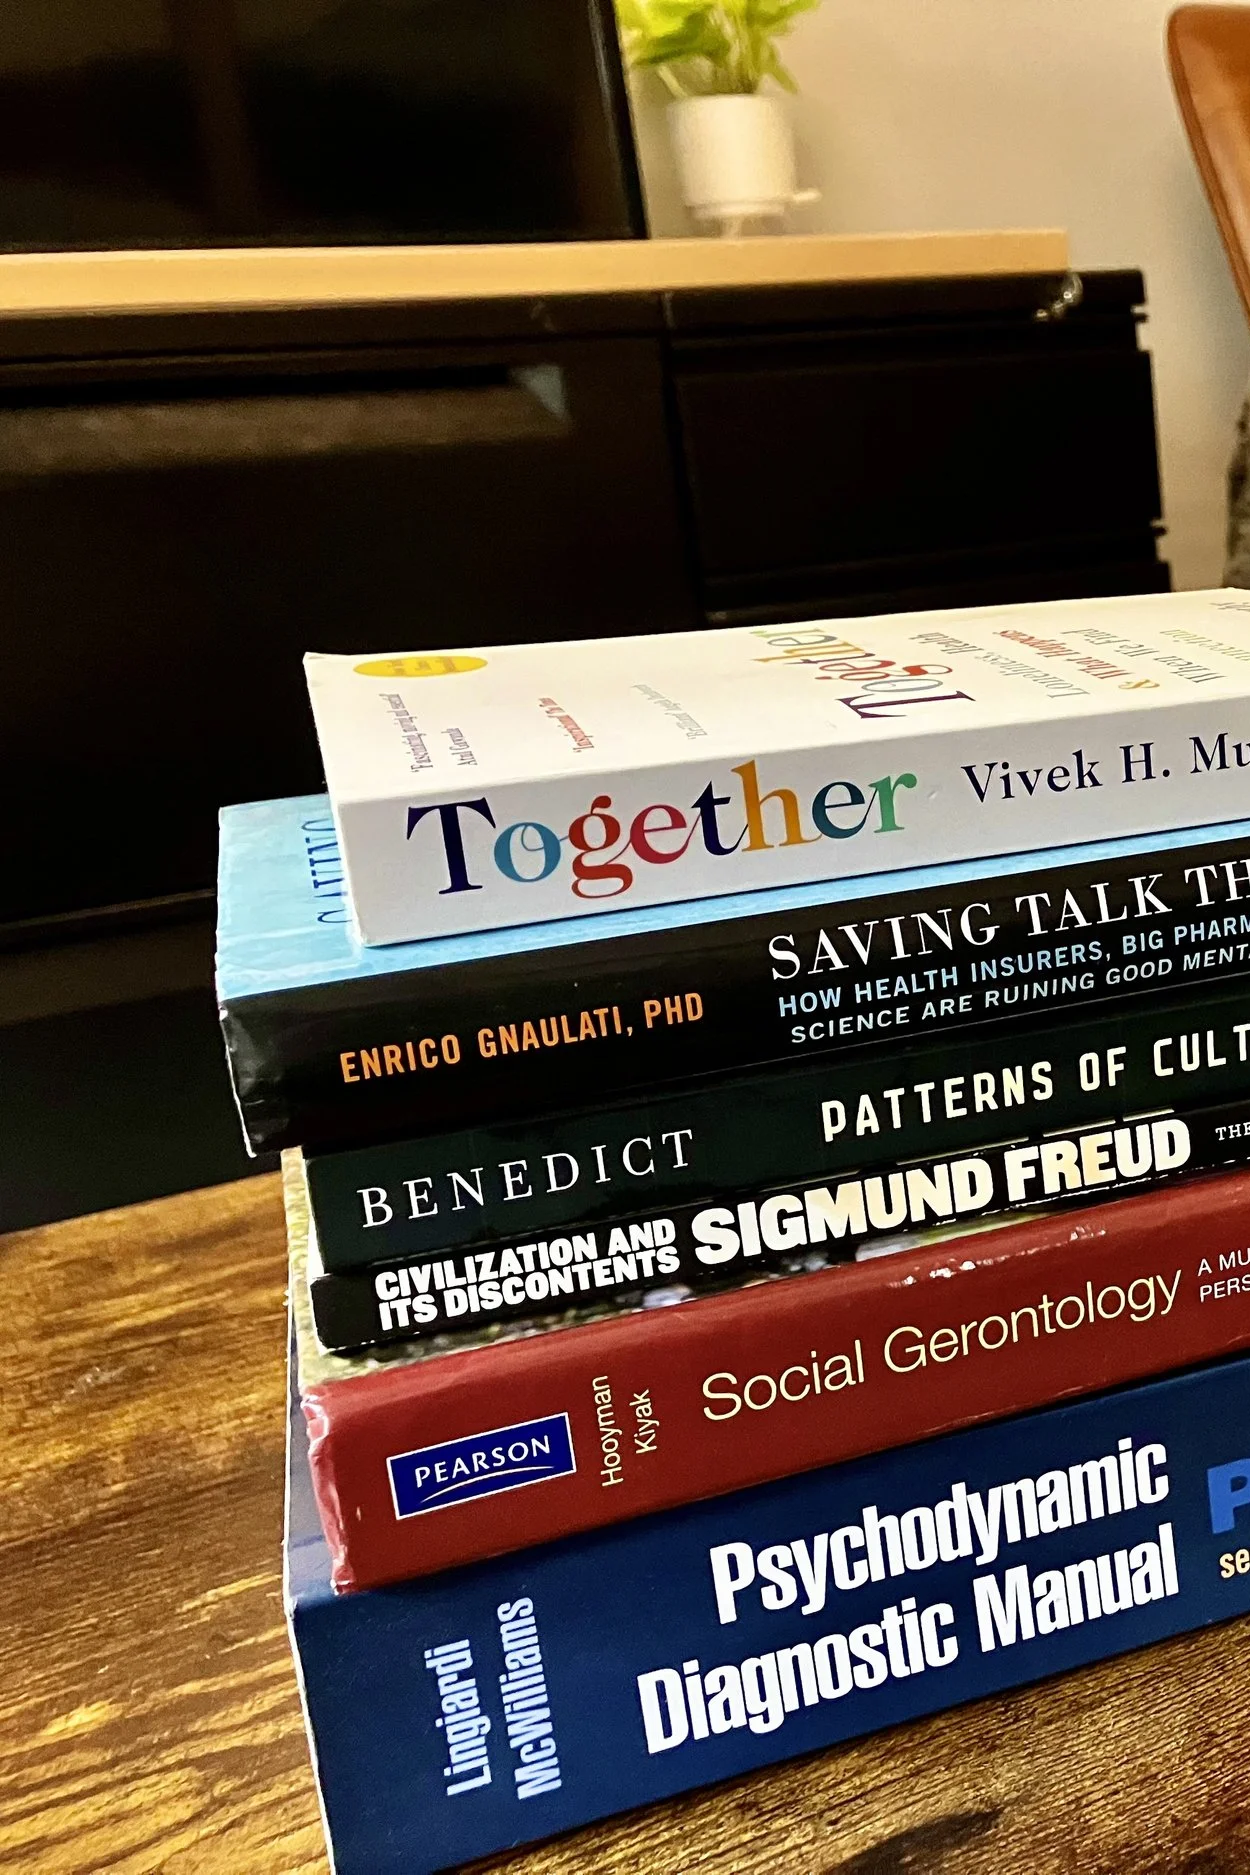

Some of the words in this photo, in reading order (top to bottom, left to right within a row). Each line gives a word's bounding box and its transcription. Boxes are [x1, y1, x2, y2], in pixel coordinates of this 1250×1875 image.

[749, 628, 976, 719] Together
[908, 632, 984, 654] Health
[992, 630, 1081, 658] Happens
[1060, 628, 1130, 645] Find
[1066, 656, 1133, 680] What
[1114, 645, 1160, 657] We
[1153, 655, 1228, 683] When
[1118, 679, 1160, 690] &
[407, 759, 917, 899] Together
[961, 752, 1104, 802] Vivek
[1121, 743, 1170, 783] H.
[768, 902, 1001, 981] SAVING
[1015, 873, 1173, 938] TALK
[778, 987, 842, 1017] HOW
[854, 966, 958, 1004] HEALTH
[971, 940, 1111, 983] INSURERS,
[1122, 931, 1163, 956] BIG
[791, 1007, 909, 1043] SCIENCE
[922, 996, 973, 1020] ARE
[984, 973, 1095, 1008] RUINING
[1105, 959, 1173, 986] GOOD
[340, 1034, 460, 1082] ENRICO
[478, 1006, 634, 1058] GNAULATI,
[643, 992, 704, 1028] PHD
[357, 1129, 693, 1228] BENEDICT
[821, 1061, 1054, 1143] PATTERNS
[1079, 1047, 1127, 1092] OF
[691, 1157, 993, 1265] SIGMUND
[1004, 1119, 1191, 1202] FREUD
[374, 1232, 598, 1302] CIVILIZATION
[608, 1218, 676, 1256] AND
[379, 1293, 438, 1331] ITS
[445, 1247, 680, 1318] DISCONTENTS
[1197, 1259, 1213, 1277] A
[702, 1339, 864, 1421] Social
[884, 1266, 1181, 1373] Gerontology
[415, 1436, 550, 1488] PEARSON
[593, 1375, 623, 1486] Hooyman
[630, 1389, 660, 1454] Kiyak
[710, 1437, 1170, 1624] Psychodynamic
[637, 1597, 959, 1754] Diagnostic
[973, 1523, 1179, 1652] Manual
[424, 1639, 492, 1796] Lingiardi
[497, 1597, 562, 1800] McWilliams
